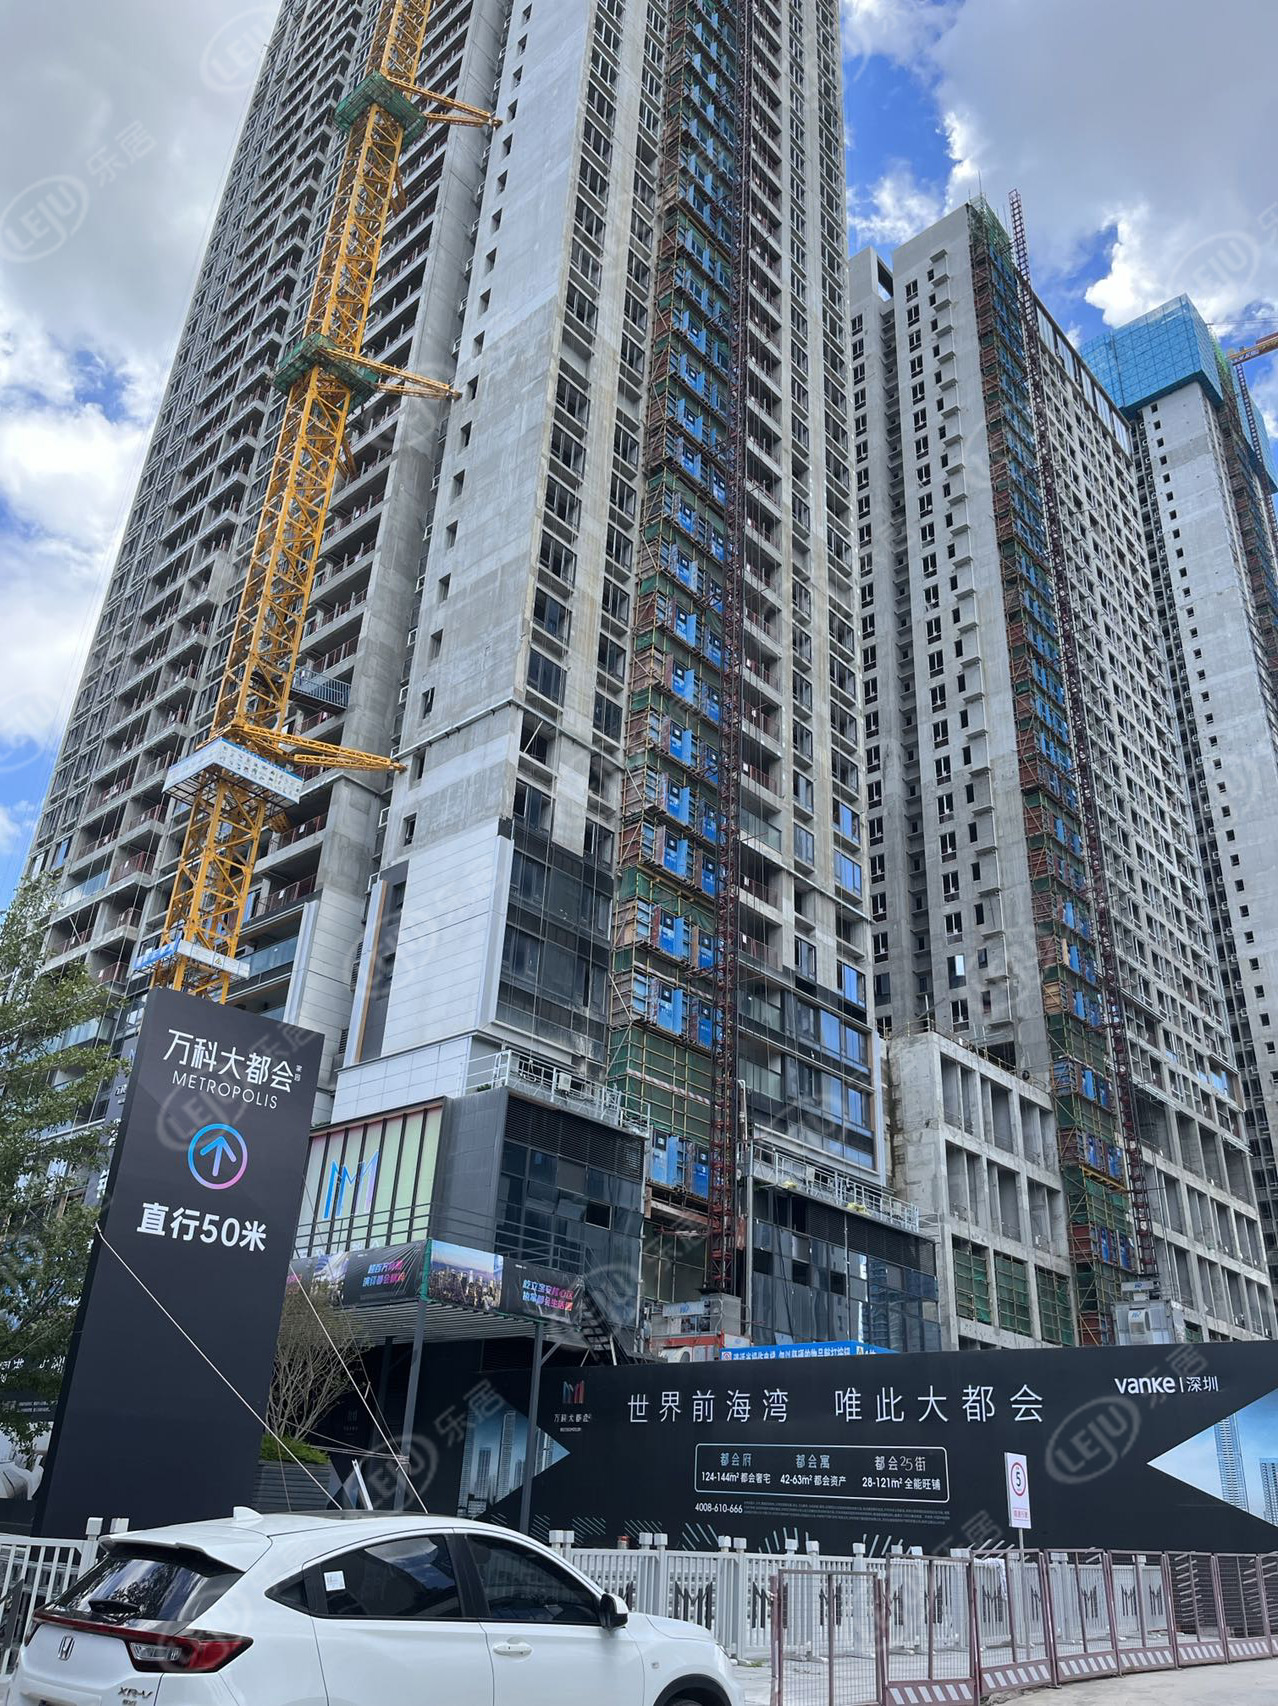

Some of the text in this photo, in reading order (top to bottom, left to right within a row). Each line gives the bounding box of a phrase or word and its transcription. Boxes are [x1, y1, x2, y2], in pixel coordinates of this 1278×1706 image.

[163, 1028, 294, 1093] 万科大都会
[172, 1070, 278, 1109] METROPOLIS
[137, 1202, 267, 1252] 直行50米
[1114, 1375, 1219, 1394] vanke 深圳
[628, 1384, 1044, 1423] 世界前海湾 唯此大都会
[720, 1452, 752, 1467] 都会府
[795, 1454, 830, 1469] 都会寓
[814, 1475, 846, 1487] 都会资产
[904, 1477, 941, 1491] 全能旺铺
[1015, 1471, 1022, 1487] 5
[694, 1502, 743, 1514] 4008-610-666
[118, 1687, 153, 1699] XR-V
